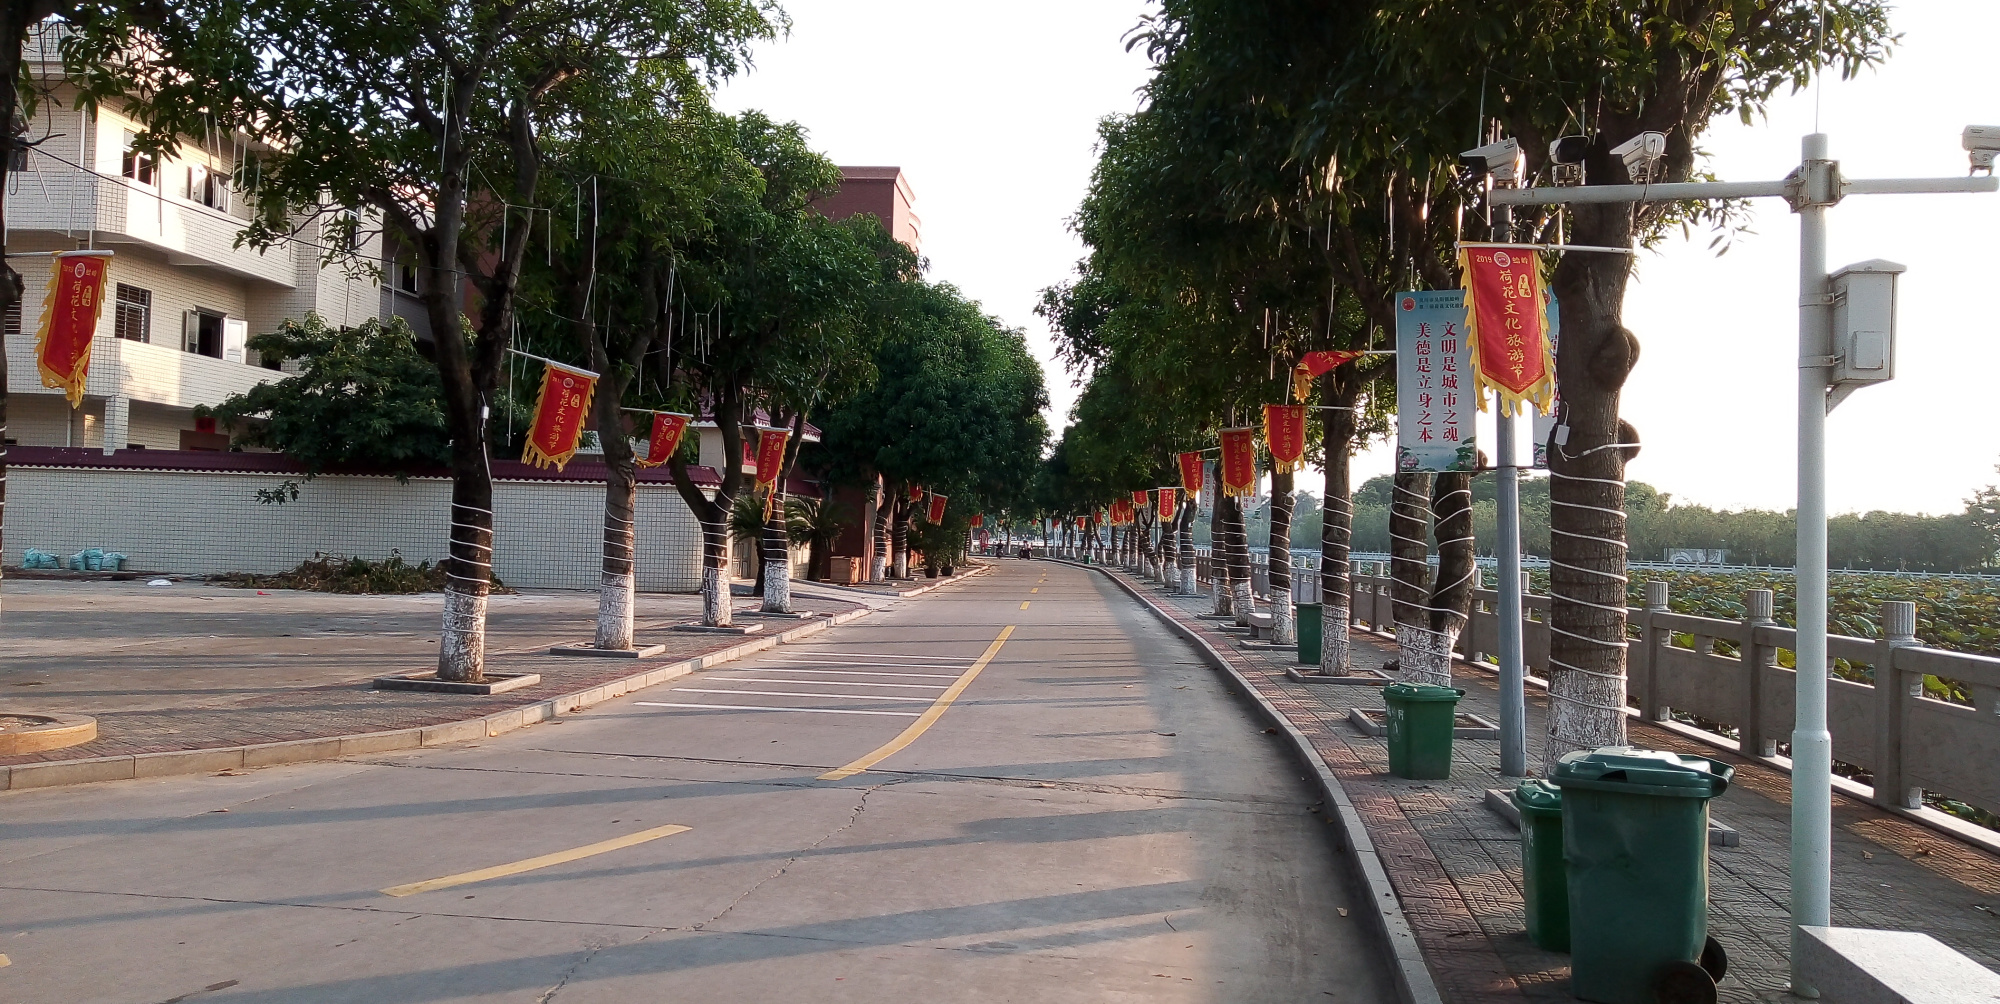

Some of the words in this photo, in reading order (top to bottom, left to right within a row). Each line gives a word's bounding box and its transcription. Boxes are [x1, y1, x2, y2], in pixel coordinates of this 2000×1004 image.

[1476, 254, 1493, 264] 2019
[1415, 322, 1434, 443] 美德是立身之本
[1440, 321, 1459, 442] 文明是城市之魂
[1498, 268, 1526, 382] 荷花文化旅游节
